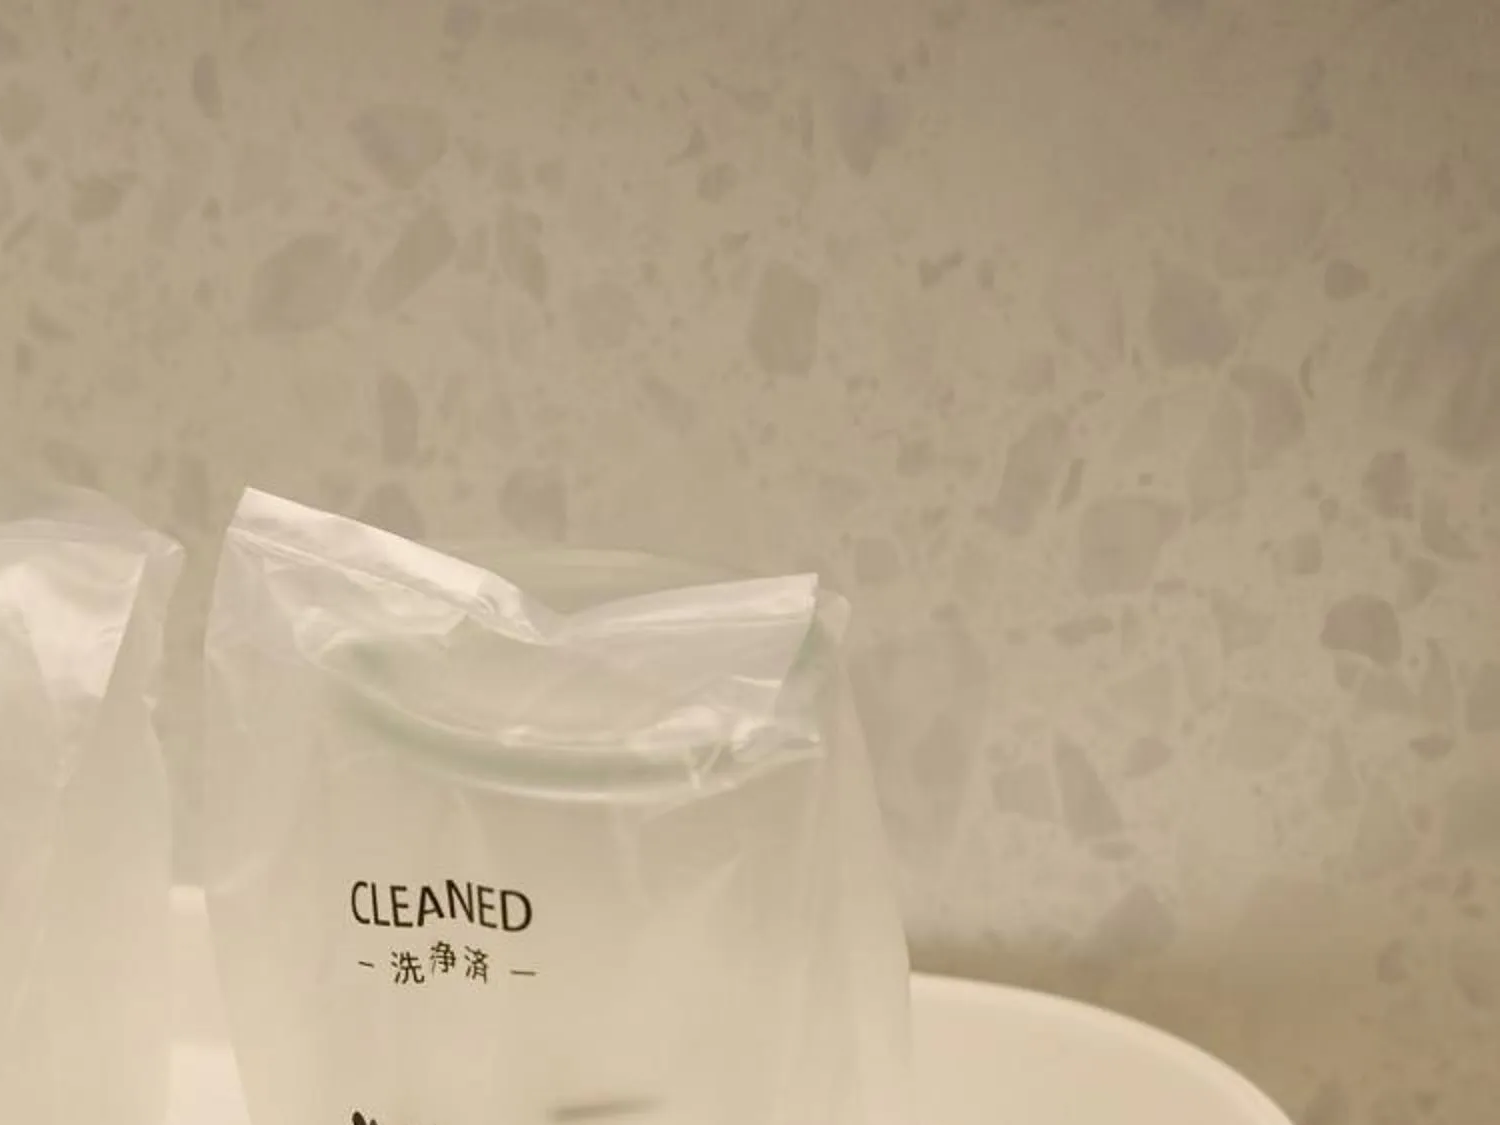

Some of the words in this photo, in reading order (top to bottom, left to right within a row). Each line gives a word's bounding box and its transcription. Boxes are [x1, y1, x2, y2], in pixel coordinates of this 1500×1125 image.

[350, 879, 533, 932] CLEANED
[389, 941, 489, 985] 洗浄済
